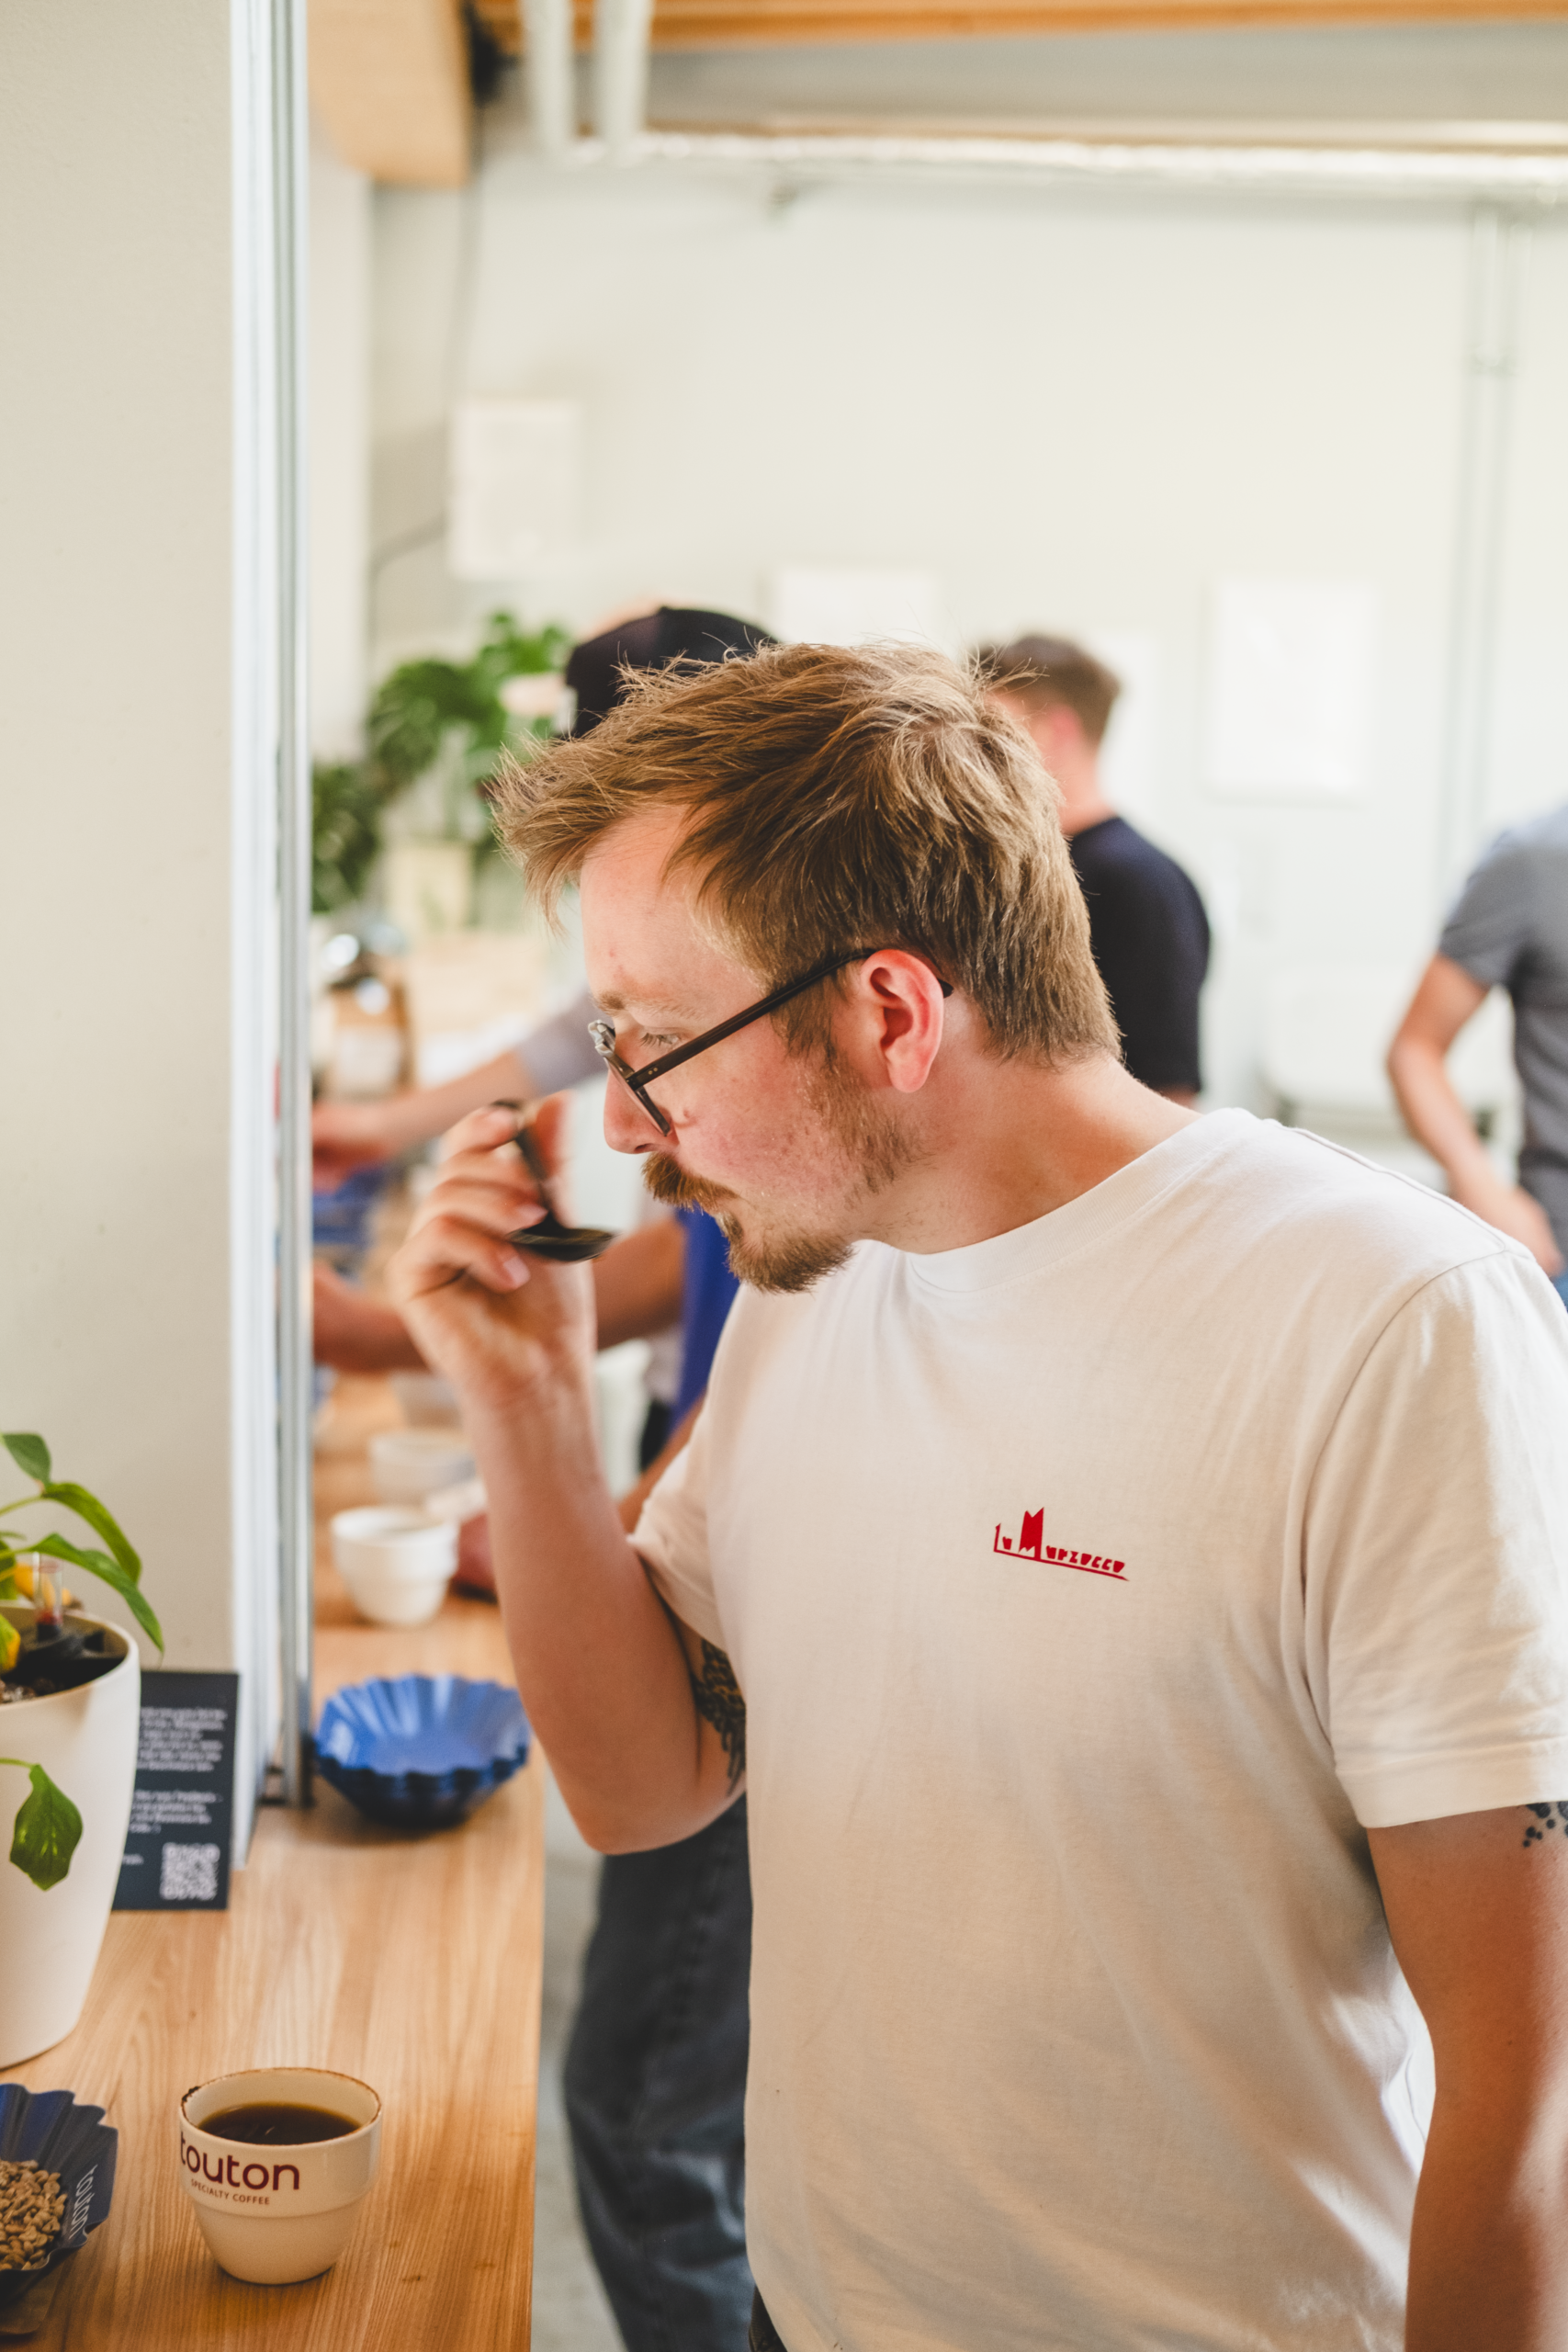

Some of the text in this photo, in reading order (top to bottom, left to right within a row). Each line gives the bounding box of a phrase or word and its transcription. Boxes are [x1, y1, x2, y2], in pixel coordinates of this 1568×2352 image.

[180, 2131, 300, 2191] touton
[68, 2164, 98, 2240] touton
[190, 2178, 270, 2206] SPECIALTY COFFEE
